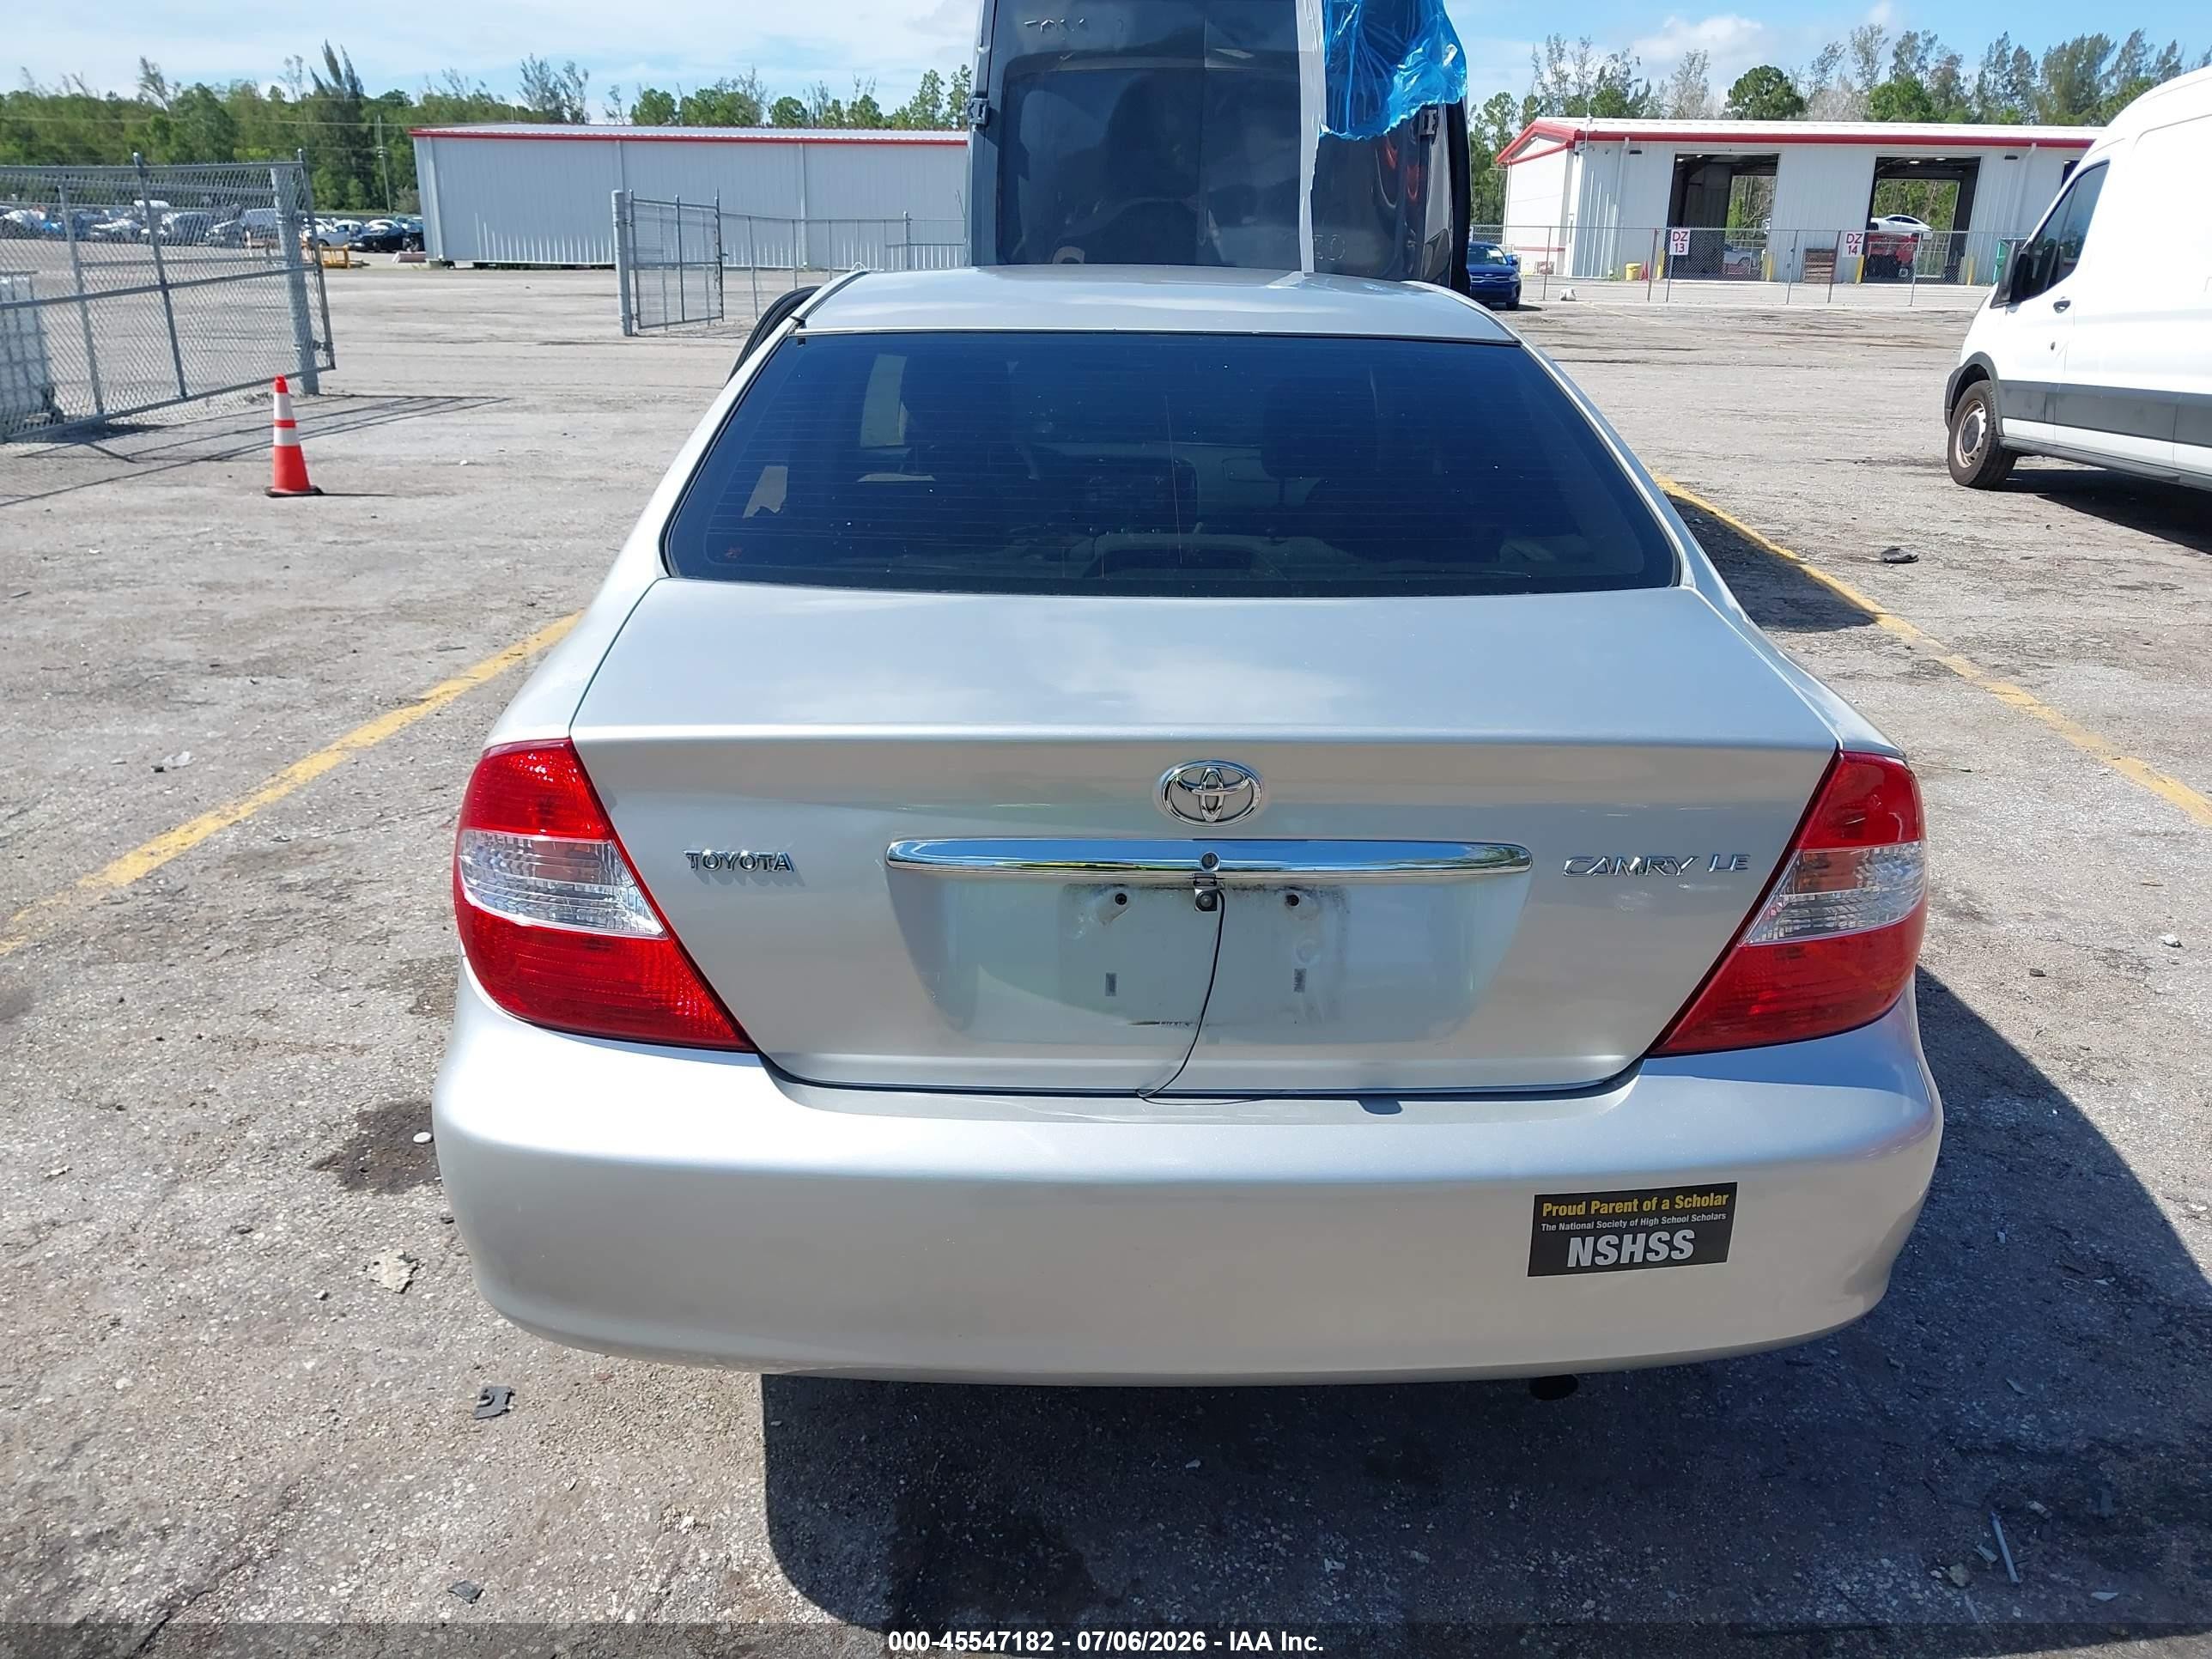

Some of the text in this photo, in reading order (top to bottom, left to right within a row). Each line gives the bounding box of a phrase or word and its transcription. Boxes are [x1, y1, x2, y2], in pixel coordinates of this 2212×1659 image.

[1673, 231, 1688, 241] DZ
[1846, 234, 1863, 244] DZ
[1674, 243, 1685, 253] 13
[1848, 245, 1858, 254] 14
[683, 850, 794, 872] TOYOTA
[1562, 854, 1750, 877] CAMRY LE
[1542, 1193, 1729, 1217] Proud Parent of a Scholar
[1541, 1223, 1556, 1231] The
[1559, 1221, 1595, 1231] National
[1596, 1219, 1627, 1229] Society
[1640, 1217, 1659, 1226] High
[1661, 1215, 1689, 1224] School
[1692, 1212, 1726, 1222] Scholars
[1566, 1230, 1695, 1267] NSHSS
